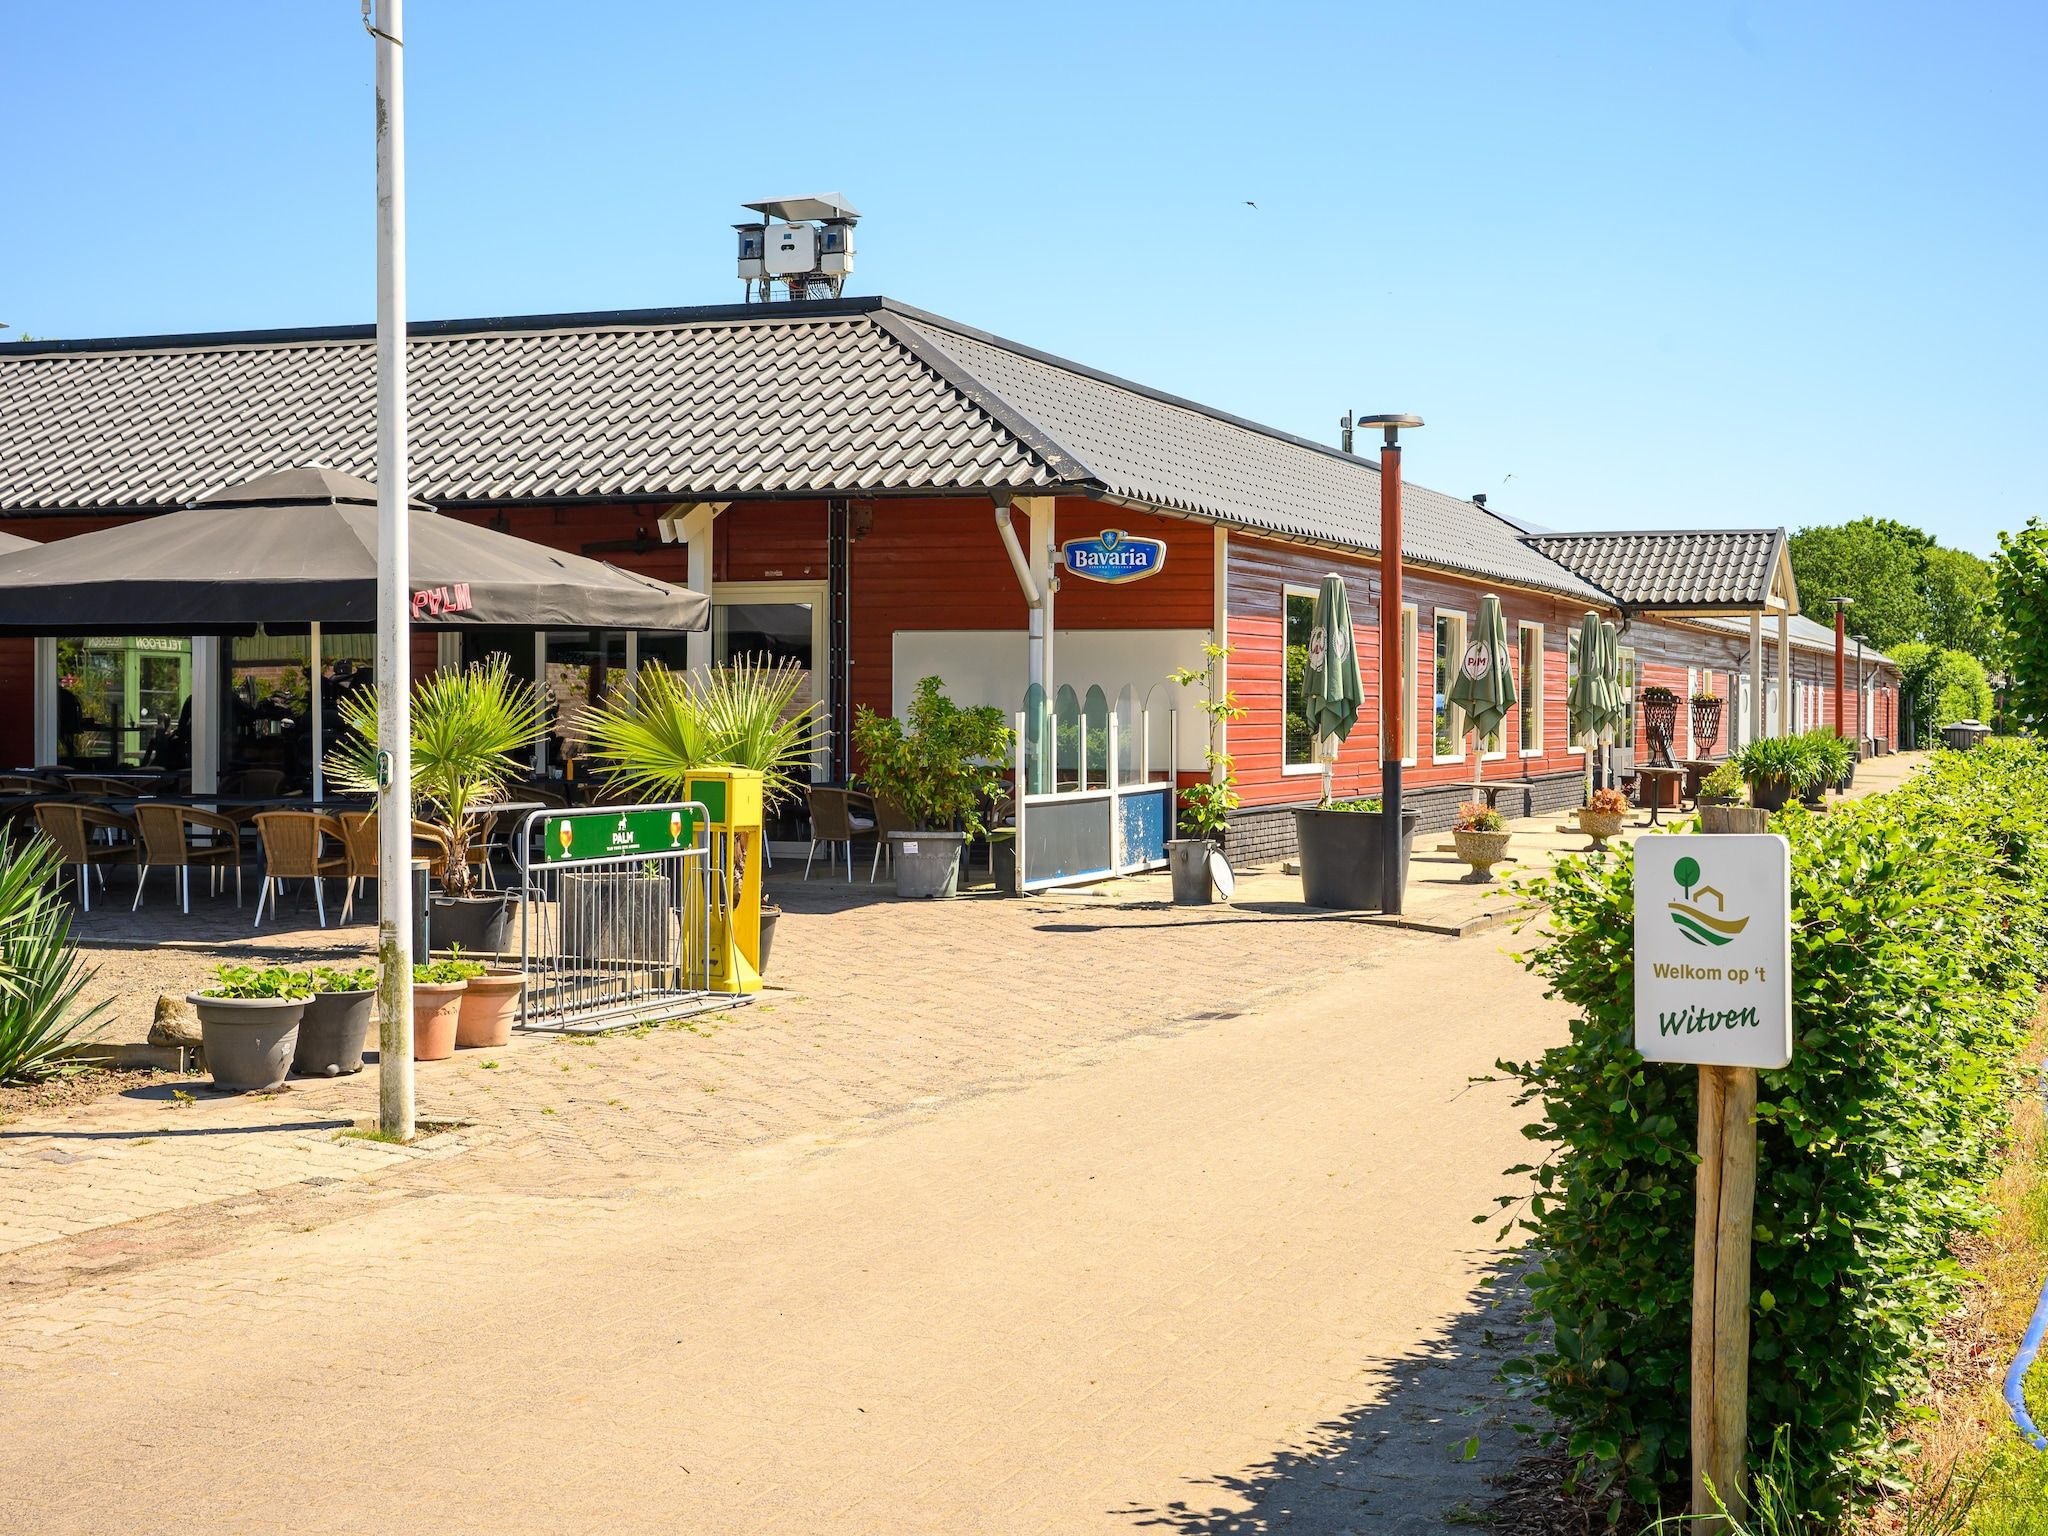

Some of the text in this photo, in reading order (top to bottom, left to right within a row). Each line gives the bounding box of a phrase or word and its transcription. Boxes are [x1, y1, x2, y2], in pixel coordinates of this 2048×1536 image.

[1075, 548, 1147, 567] Bavaria
[612, 831, 634, 845] PALM
[1653, 963, 1722, 981] Welkom
[1727, 968, 1749, 985] op
[1659, 1005, 1760, 1037] Witven
